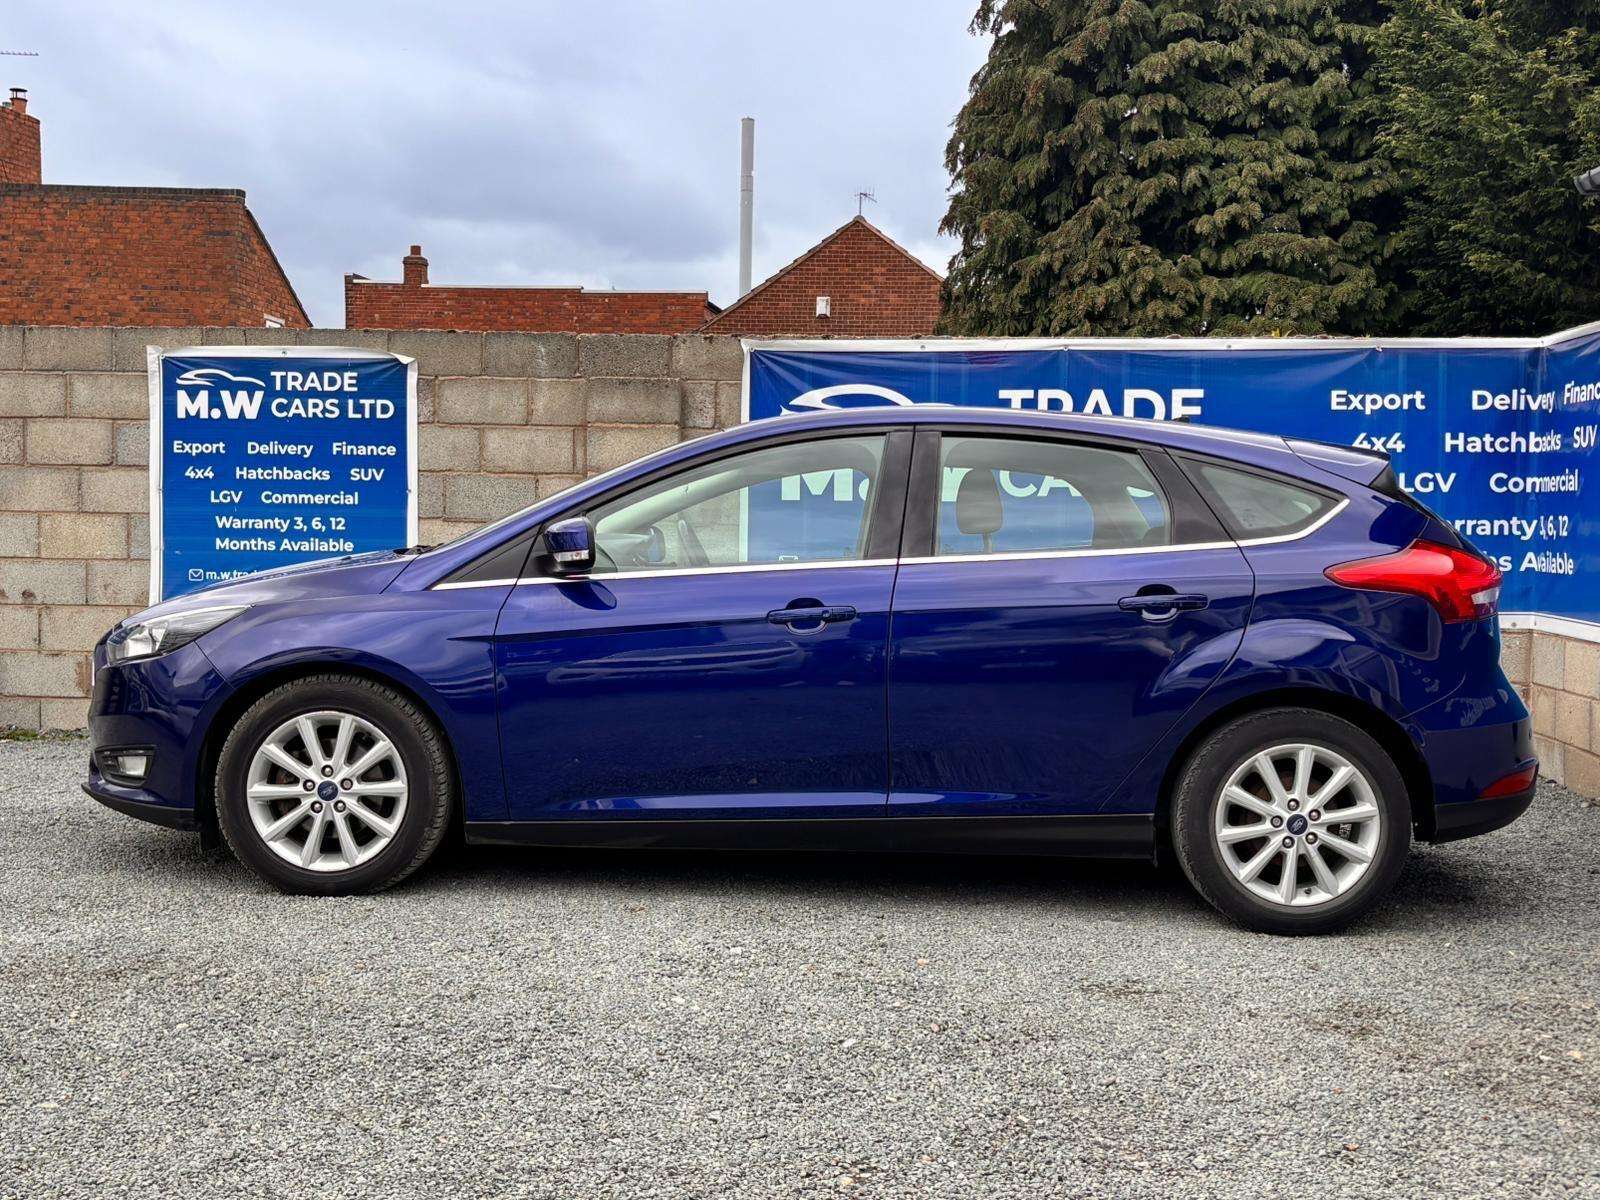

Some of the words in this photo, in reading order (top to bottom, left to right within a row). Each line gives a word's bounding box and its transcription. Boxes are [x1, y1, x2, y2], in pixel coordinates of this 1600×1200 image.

[271, 372, 358, 392] TRADE
[176, 390, 265, 420] M.W
[1331, 389, 1426, 415] Export
[1472, 389, 1556, 414] Delivery
[1564, 380, 1600, 405] Financ
[271, 398, 340, 419] CARS
[348, 399, 395, 419] LTD
[173, 441, 226, 456] Export
[247, 442, 314, 457] Delivery
[332, 443, 397, 456] Finance
[1352, 432, 1405, 453] 4x4
[1445, 431, 1561, 453] Hatchbacks
[1573, 425, 1598, 448] SUV
[184, 467, 215, 479] 4x4
[235, 467, 331, 481] Hatchbacks
[350, 469, 385, 481] SUV
[1399, 472, 1456, 493] LGV
[1489, 468, 1579, 493] Commercial
[210, 491, 243, 503] LGV
[261, 491, 359, 505] Commercial
[215, 516, 290, 531] Warranty
[293, 517, 308, 531] 3,
[311, 517, 326, 532] 6,
[330, 518, 346, 530] 12
[1446, 516, 1538, 540] rranty
[1547, 515, 1556, 540] 6,
[1558, 515, 1568, 537] 12
[215, 538, 276, 551] Months
[279, 538, 355, 552] Available
